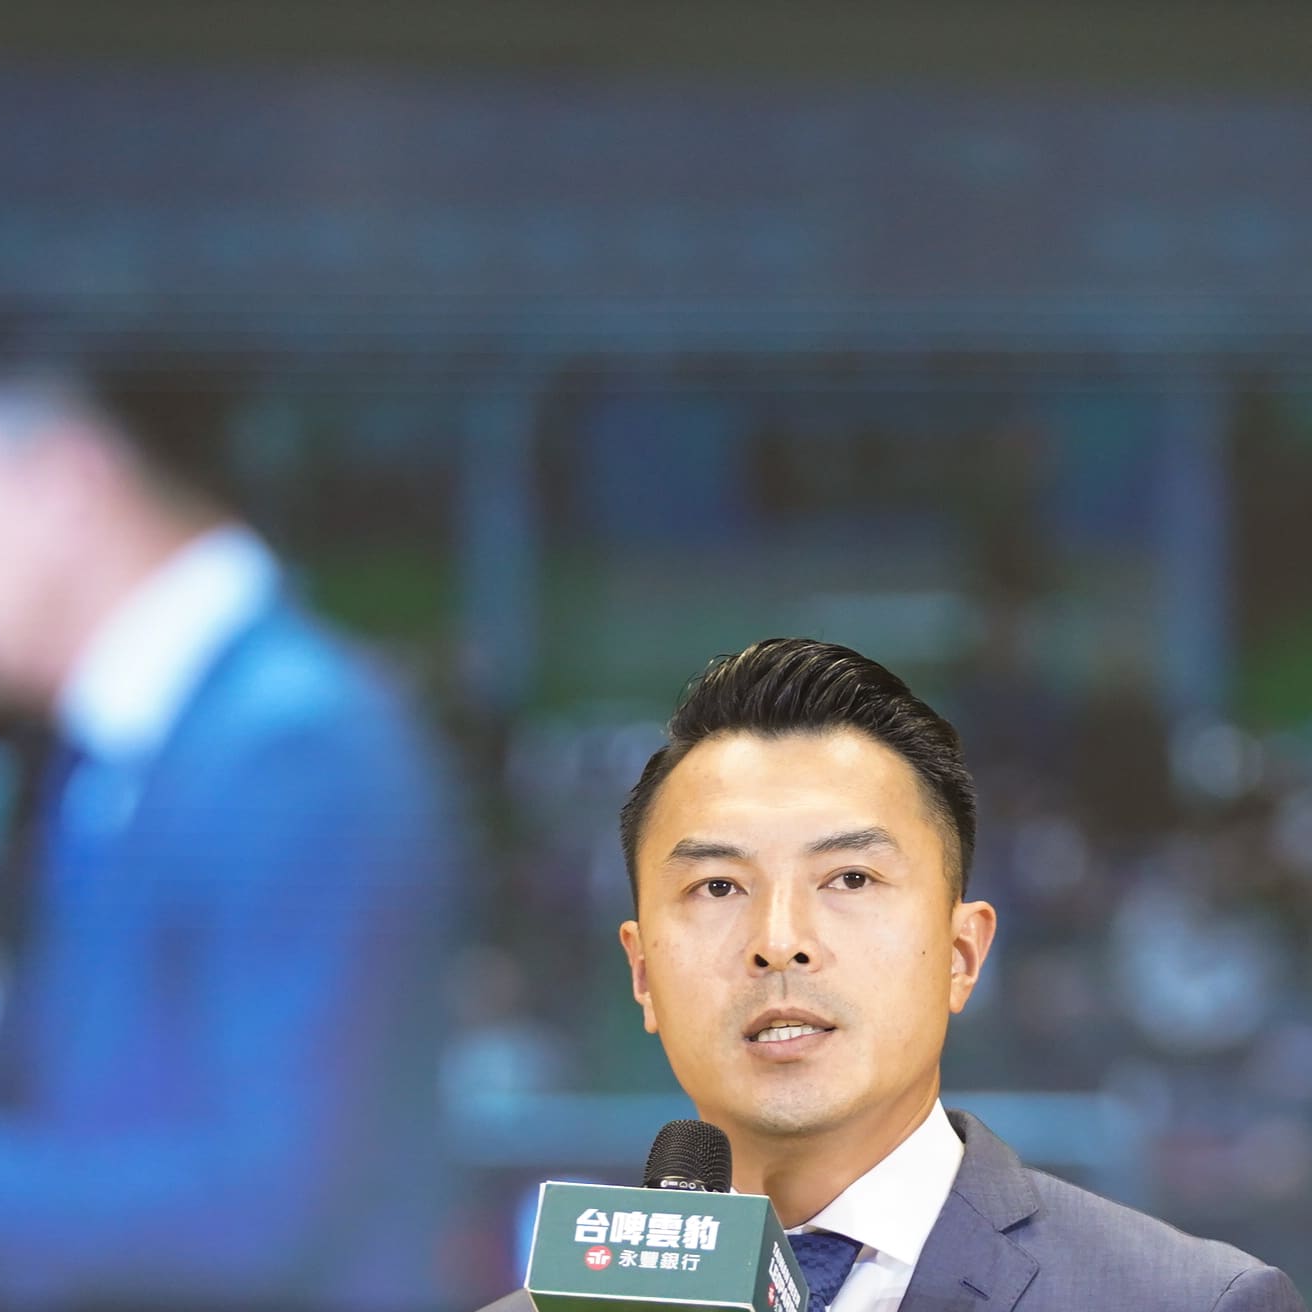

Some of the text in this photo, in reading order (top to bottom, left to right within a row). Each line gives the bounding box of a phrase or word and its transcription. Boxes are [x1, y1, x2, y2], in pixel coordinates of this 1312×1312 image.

[574, 1208, 720, 1250] 台啤雲豹
[618, 1249, 701, 1271] 永豐銀行
